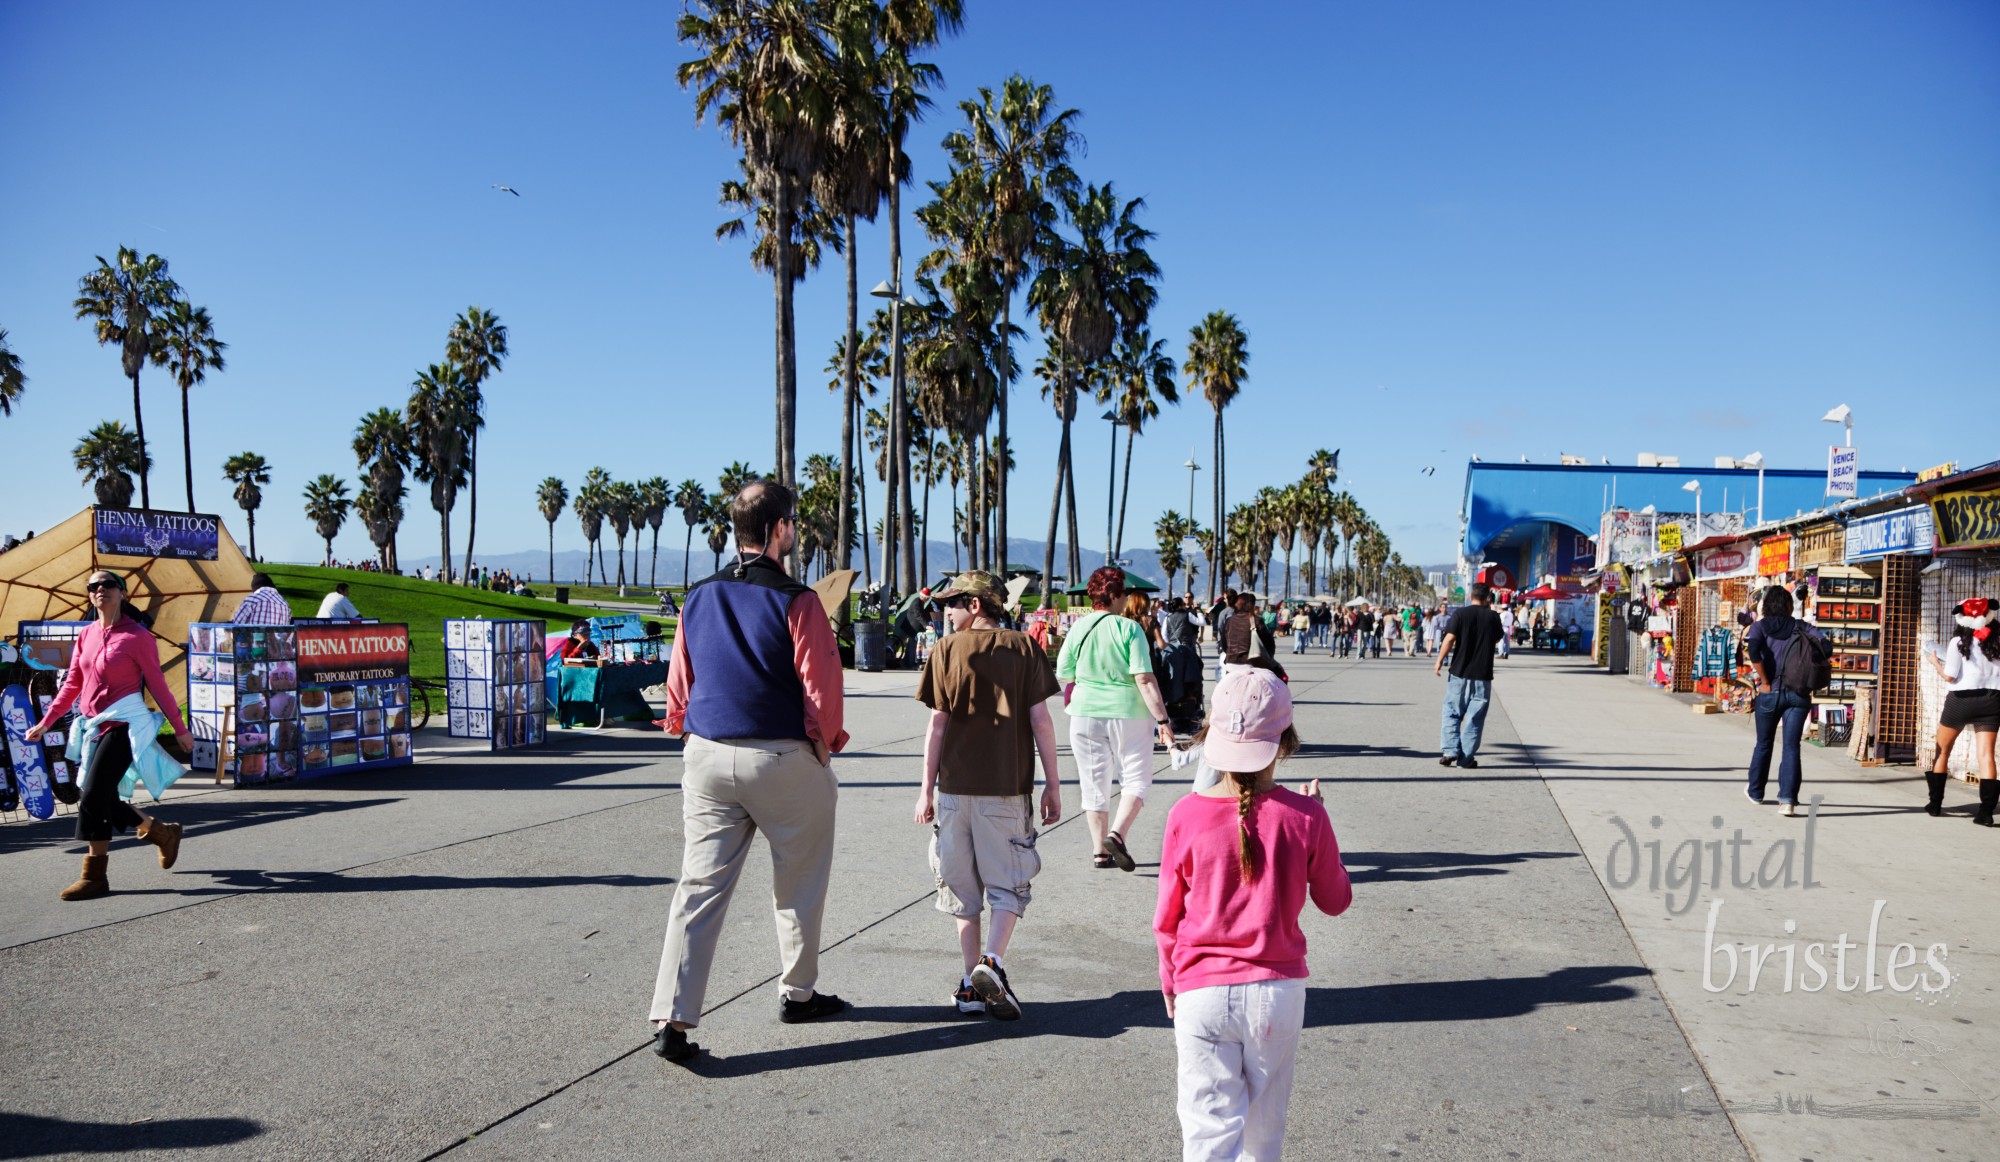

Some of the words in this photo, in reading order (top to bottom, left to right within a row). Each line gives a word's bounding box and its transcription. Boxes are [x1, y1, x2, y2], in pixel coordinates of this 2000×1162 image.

[1833, 452, 1854, 464] VENICE
[1833, 465, 1853, 477] BEACH
[1831, 481, 1854, 491] PHOTOS
[97, 510, 146, 527] HENNA
[154, 514, 216, 533] TATTOOS
[1659, 527, 1679, 535] NAME
[115, 543, 148, 553] Temporary
[176, 547, 197, 556] Tattoos
[1603, 571, 1620, 582] ATM
[299, 639, 347, 656] HENNA
[349, 636, 406, 653] TATTOOS
[315, 671, 359, 682] TEMPORARY
[361, 668, 394, 679] TATTOOS
[1230, 710, 1244, 734] B
